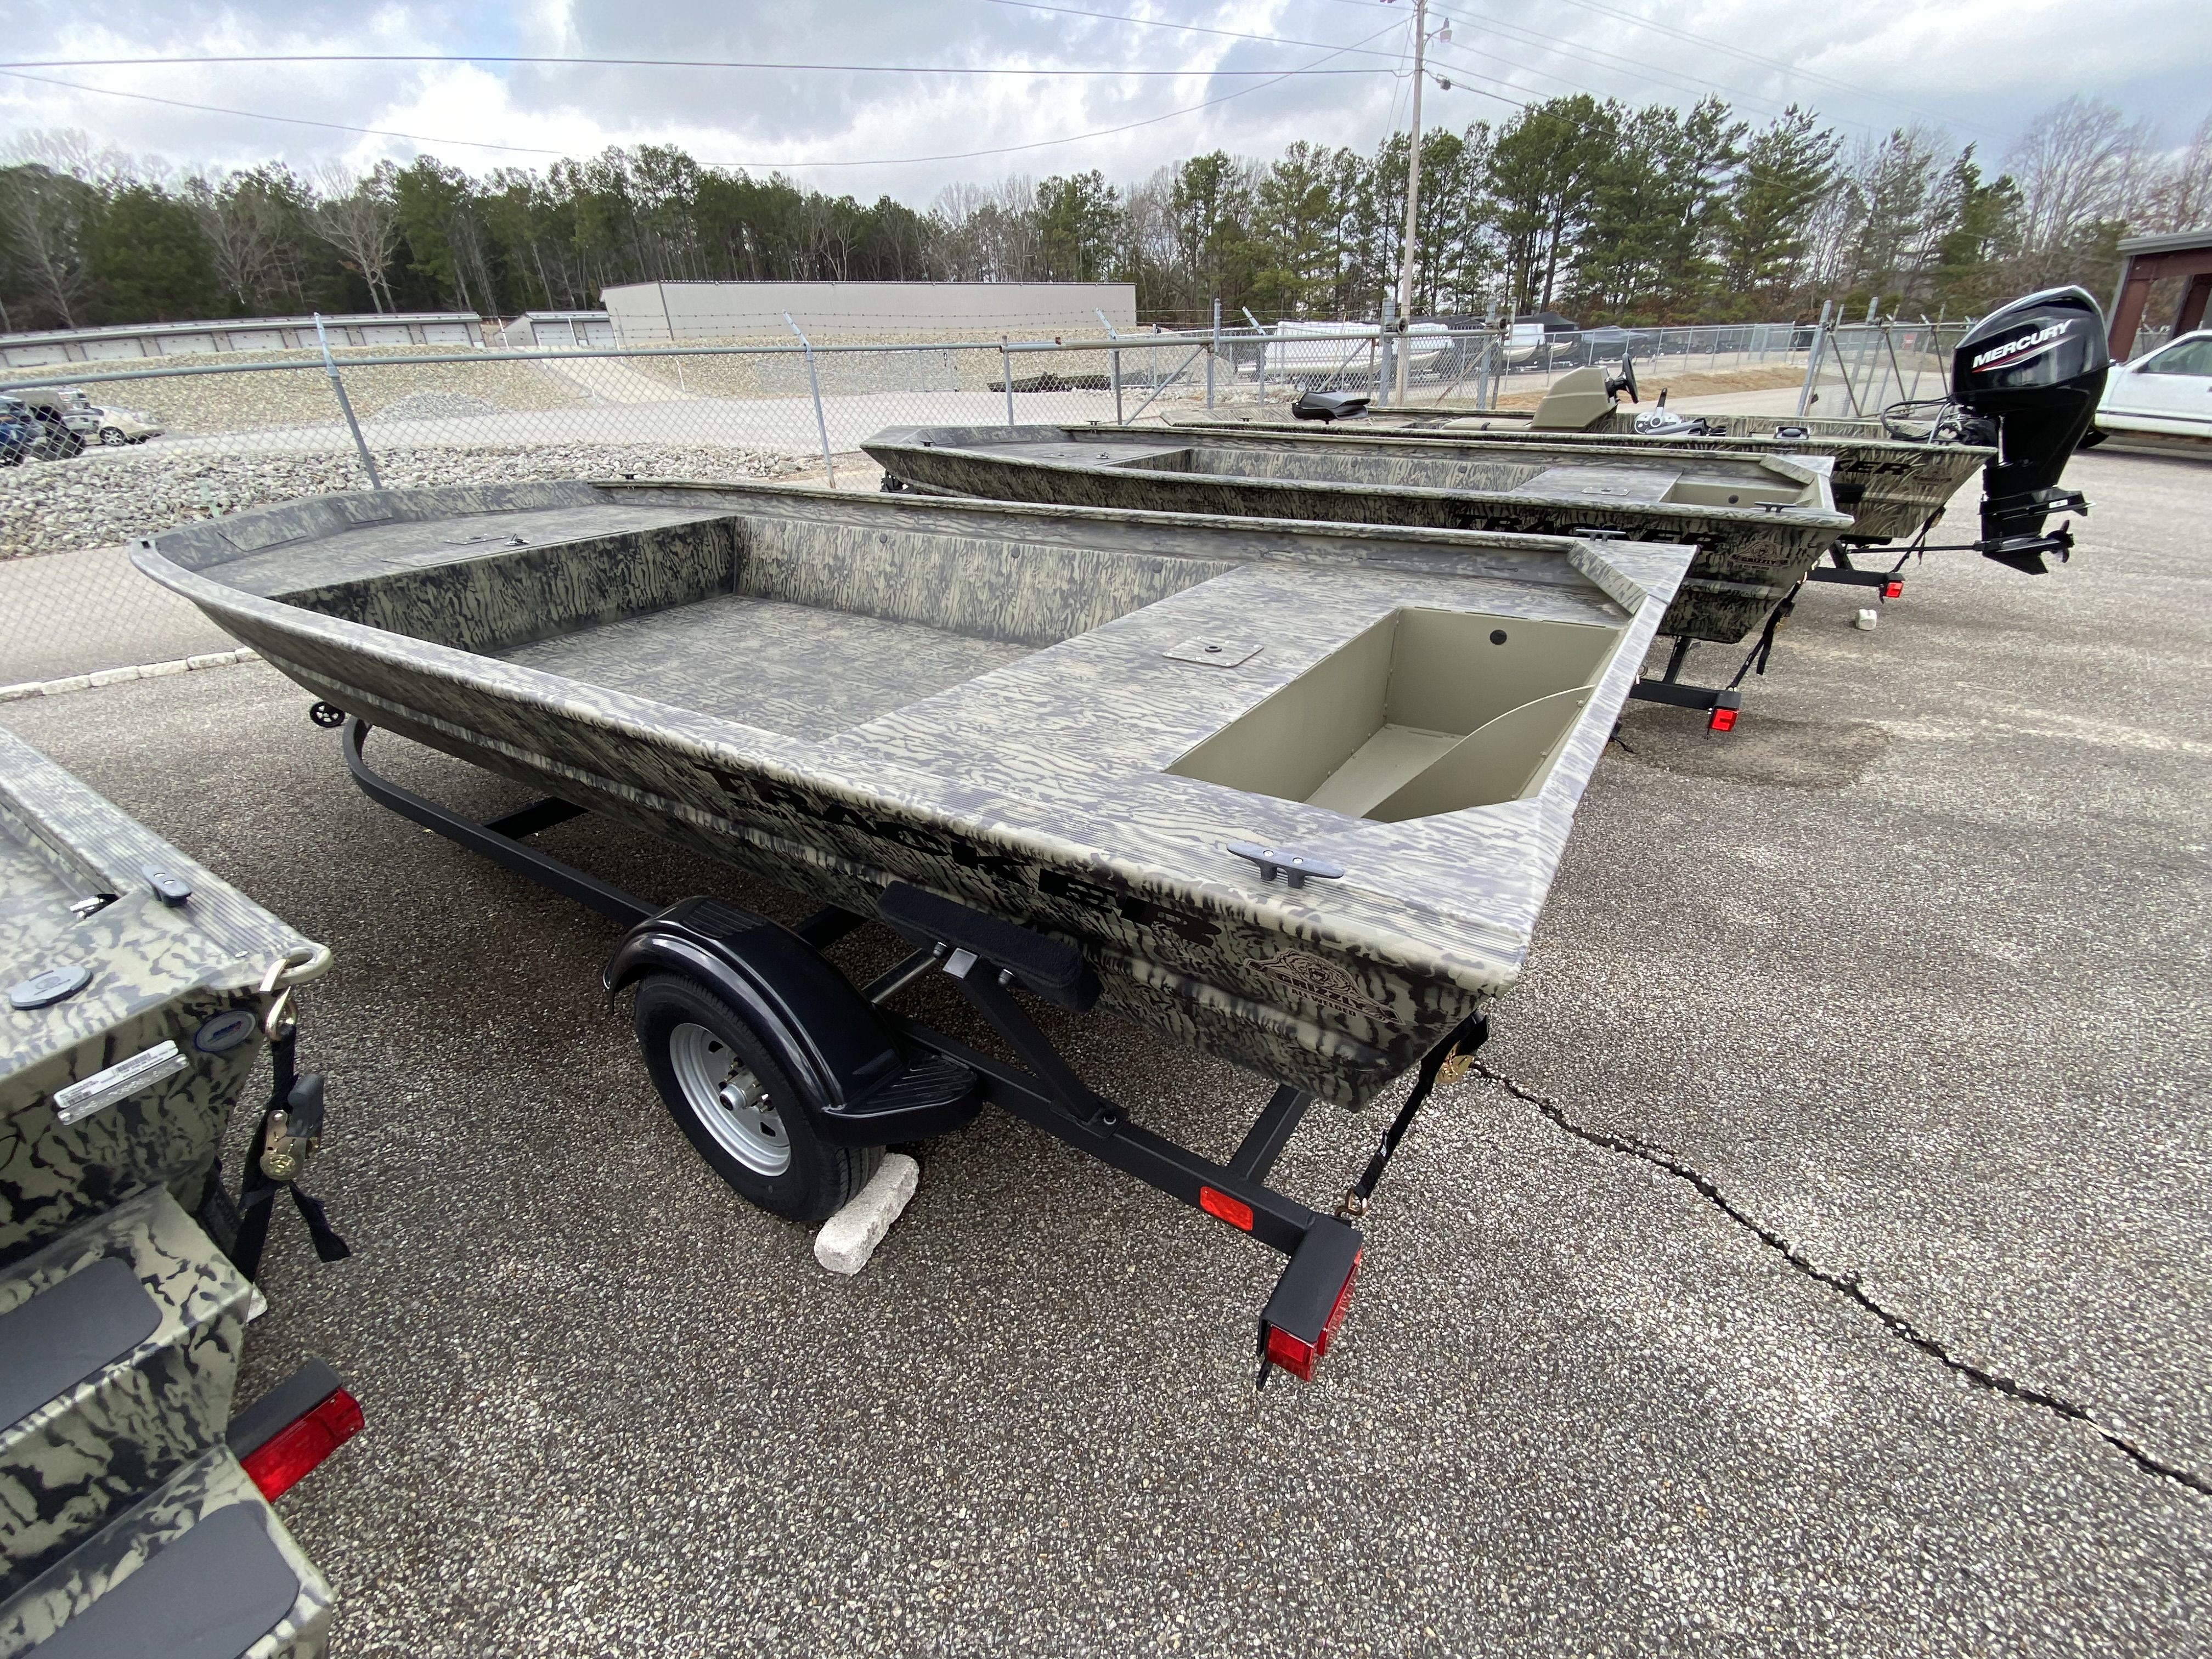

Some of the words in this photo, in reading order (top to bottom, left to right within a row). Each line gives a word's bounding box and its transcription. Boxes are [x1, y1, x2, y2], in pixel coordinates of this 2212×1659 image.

[1972, 319, 2073, 368] MERCURY
[690, 761, 1222, 947] TRACKER
[1275, 972, 1367, 1010] GRIZZLY
[1291, 989, 1310, 999] ALL
[1311, 995, 1357, 1017] WELDED
